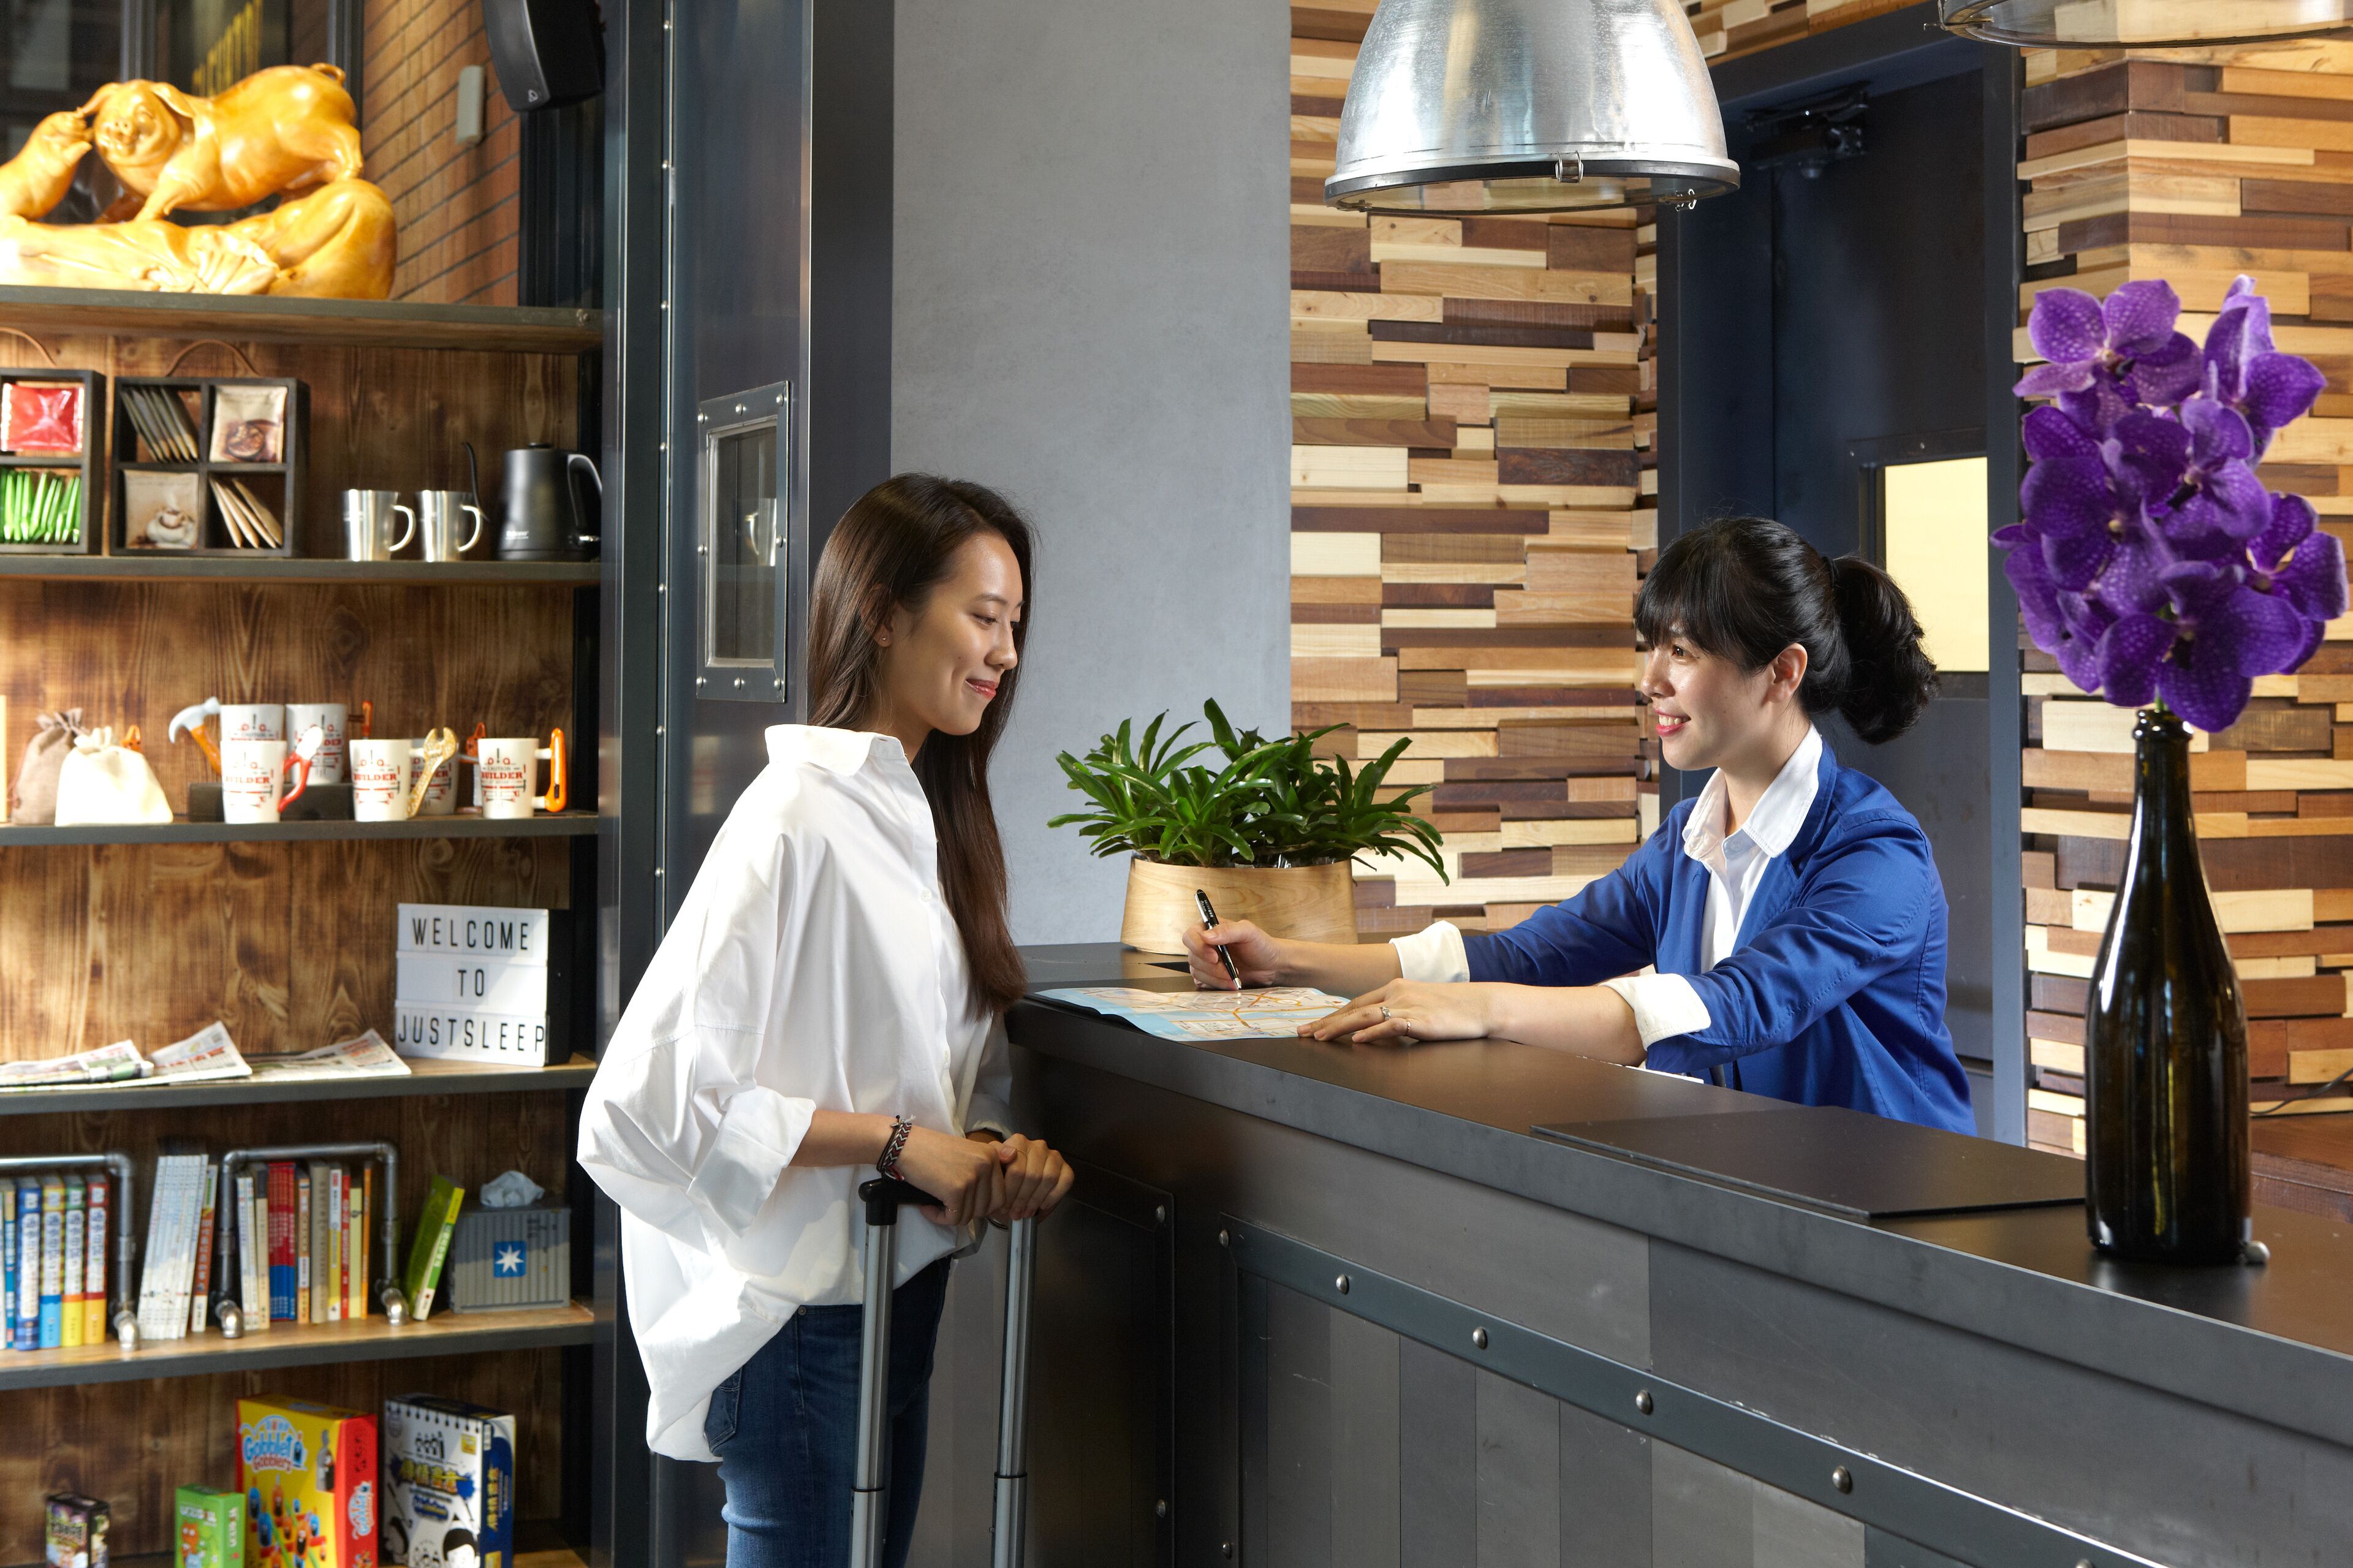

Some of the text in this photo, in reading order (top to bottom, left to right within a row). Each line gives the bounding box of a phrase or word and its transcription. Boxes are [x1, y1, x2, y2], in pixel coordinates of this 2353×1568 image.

[412, 917, 528, 950] WELCOME
[458, 969, 484, 997] TO
[398, 1014, 544, 1053] JUSTSLEEP
